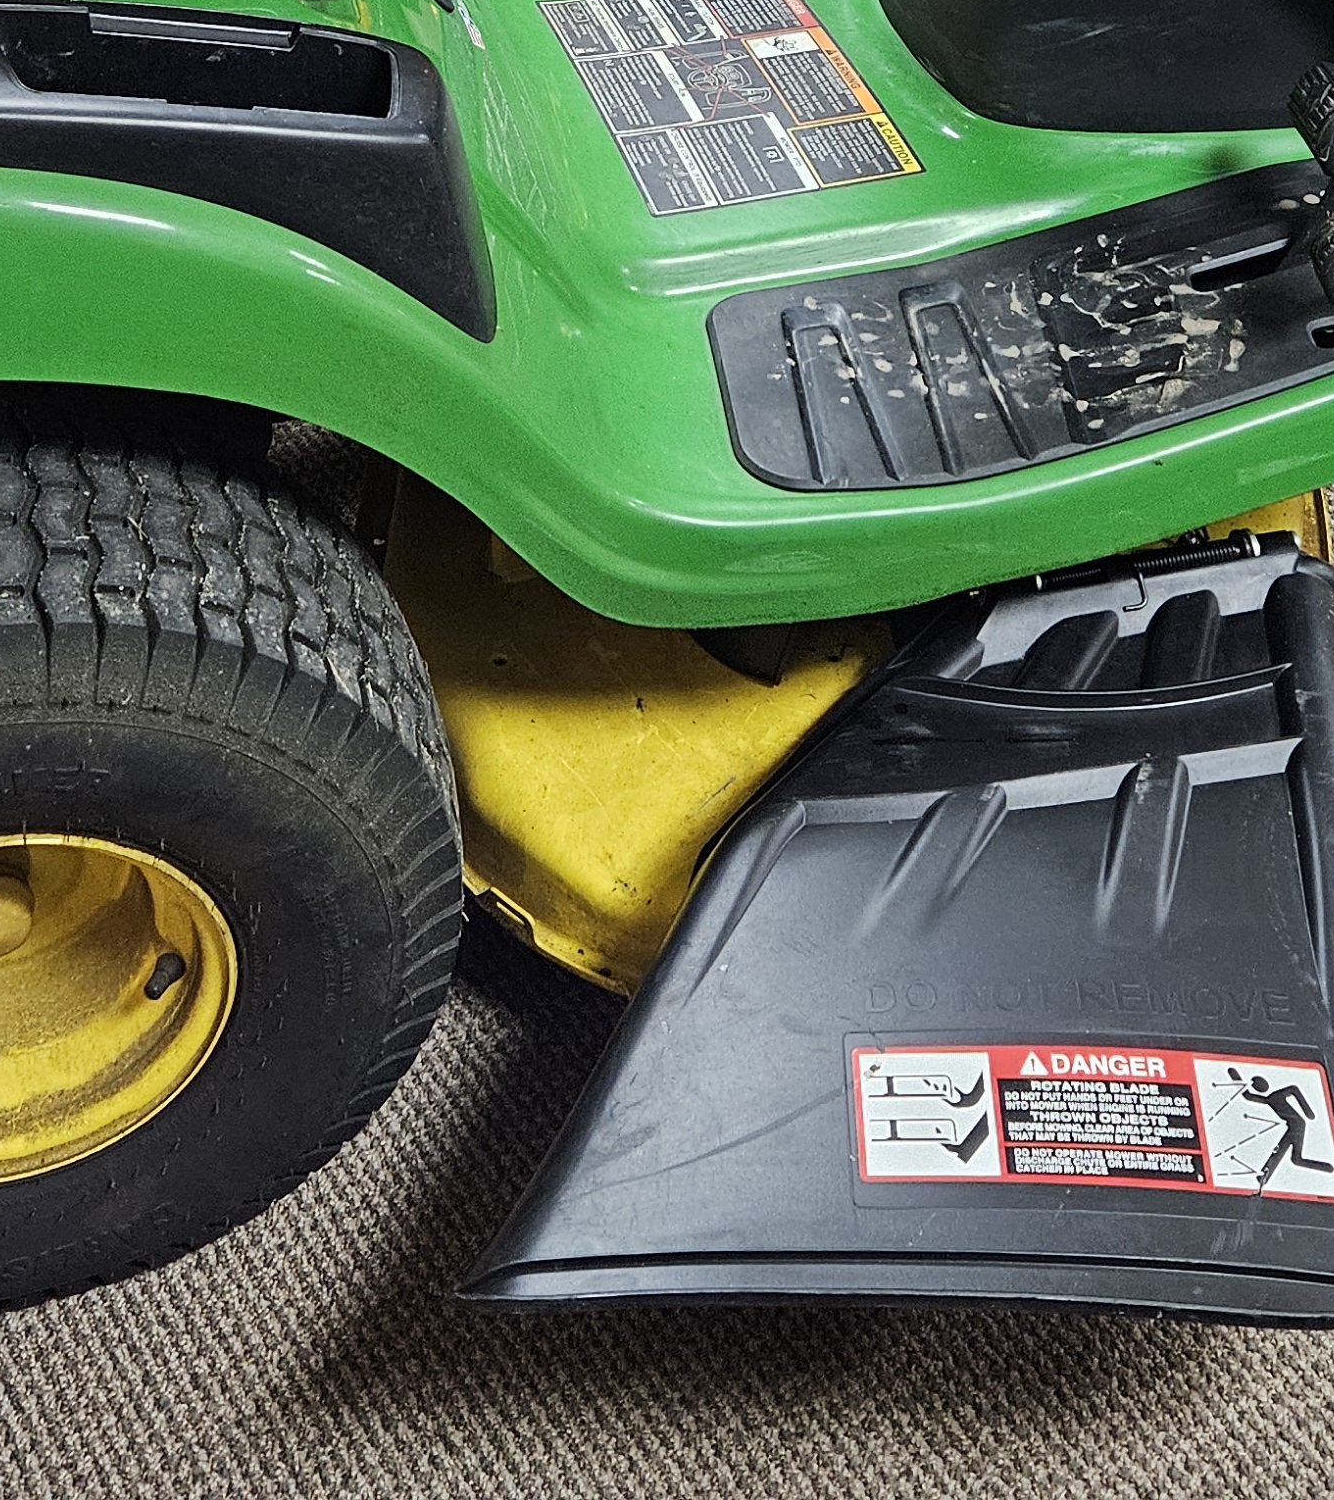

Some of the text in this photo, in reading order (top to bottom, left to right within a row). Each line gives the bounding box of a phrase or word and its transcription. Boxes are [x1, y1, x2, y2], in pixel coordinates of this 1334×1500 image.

[829, 55, 862, 89] WARNING
[879, 128, 914, 165] CAUTION
[1051, 1053, 1166, 1078] DANGER
[1031, 1081, 1159, 1095] ROTATING BLADE
[1004, 1091, 1189, 1106] DO NOT PUT HANDS OR FEET UNDER OR
[1005, 1101, 1191, 1116] INTO MOWER WHEN ENGINE IS RUNNING
[1030, 1112, 1168, 1126] THROWN OBJECTS
[1008, 1122, 1194, 1138] BEFORE MOWING, CLEAR AREA OF OBJECTS
[1009, 1132, 1162, 1145] THAT MAY BE THROWN BY BLADE
[1014, 1148, 1192, 1164] DO NOT OPERATE MOWER WITHOUT
[1016, 1165, 1109, 1175] CATCHER IN PLACE
